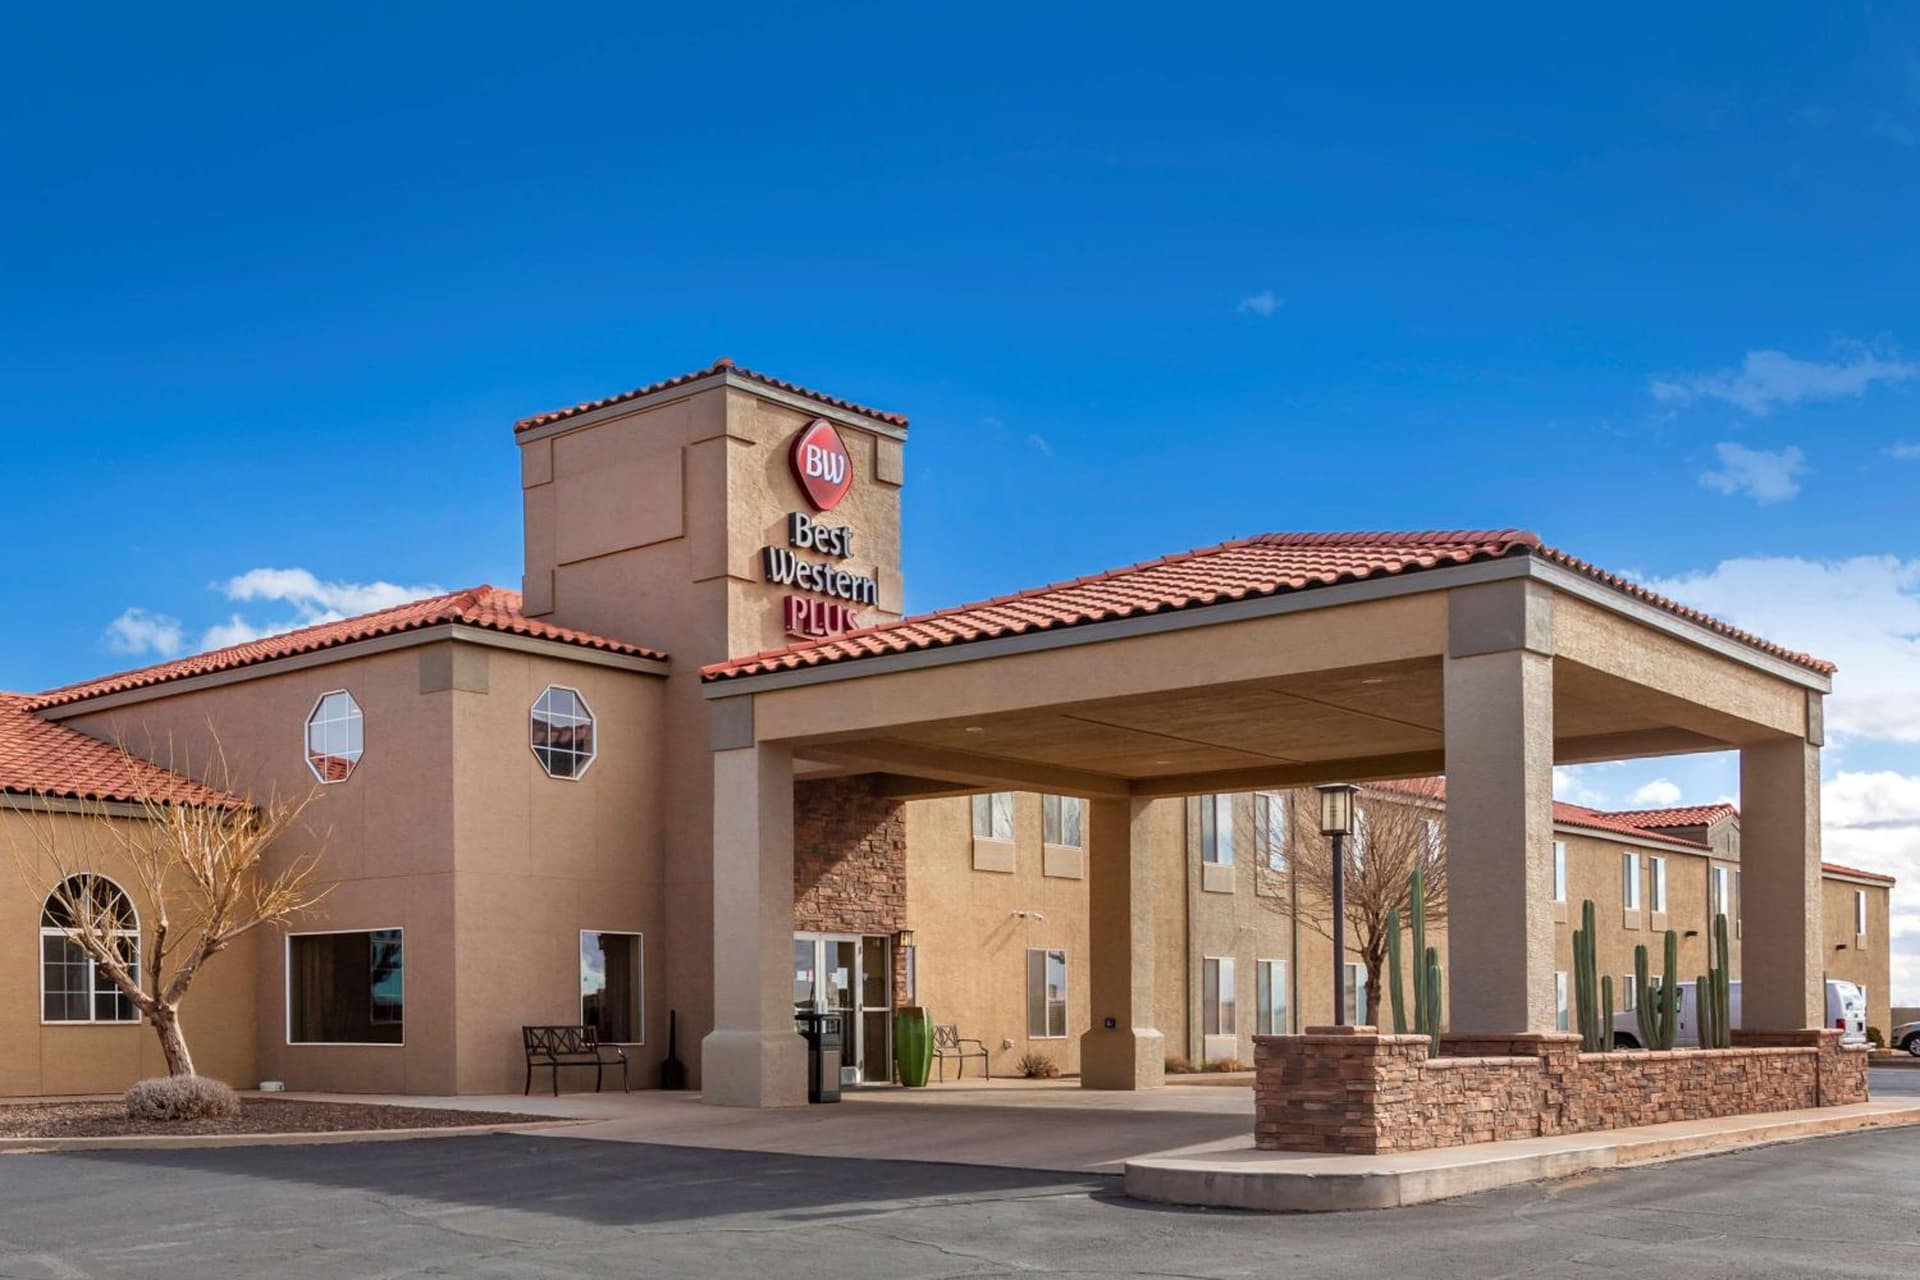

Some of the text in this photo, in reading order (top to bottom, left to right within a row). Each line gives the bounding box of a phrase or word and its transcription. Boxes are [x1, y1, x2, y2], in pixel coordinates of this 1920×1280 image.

[806, 444, 845, 484] BW
[791, 512, 854, 558] Best
[765, 546, 879, 605] Western
